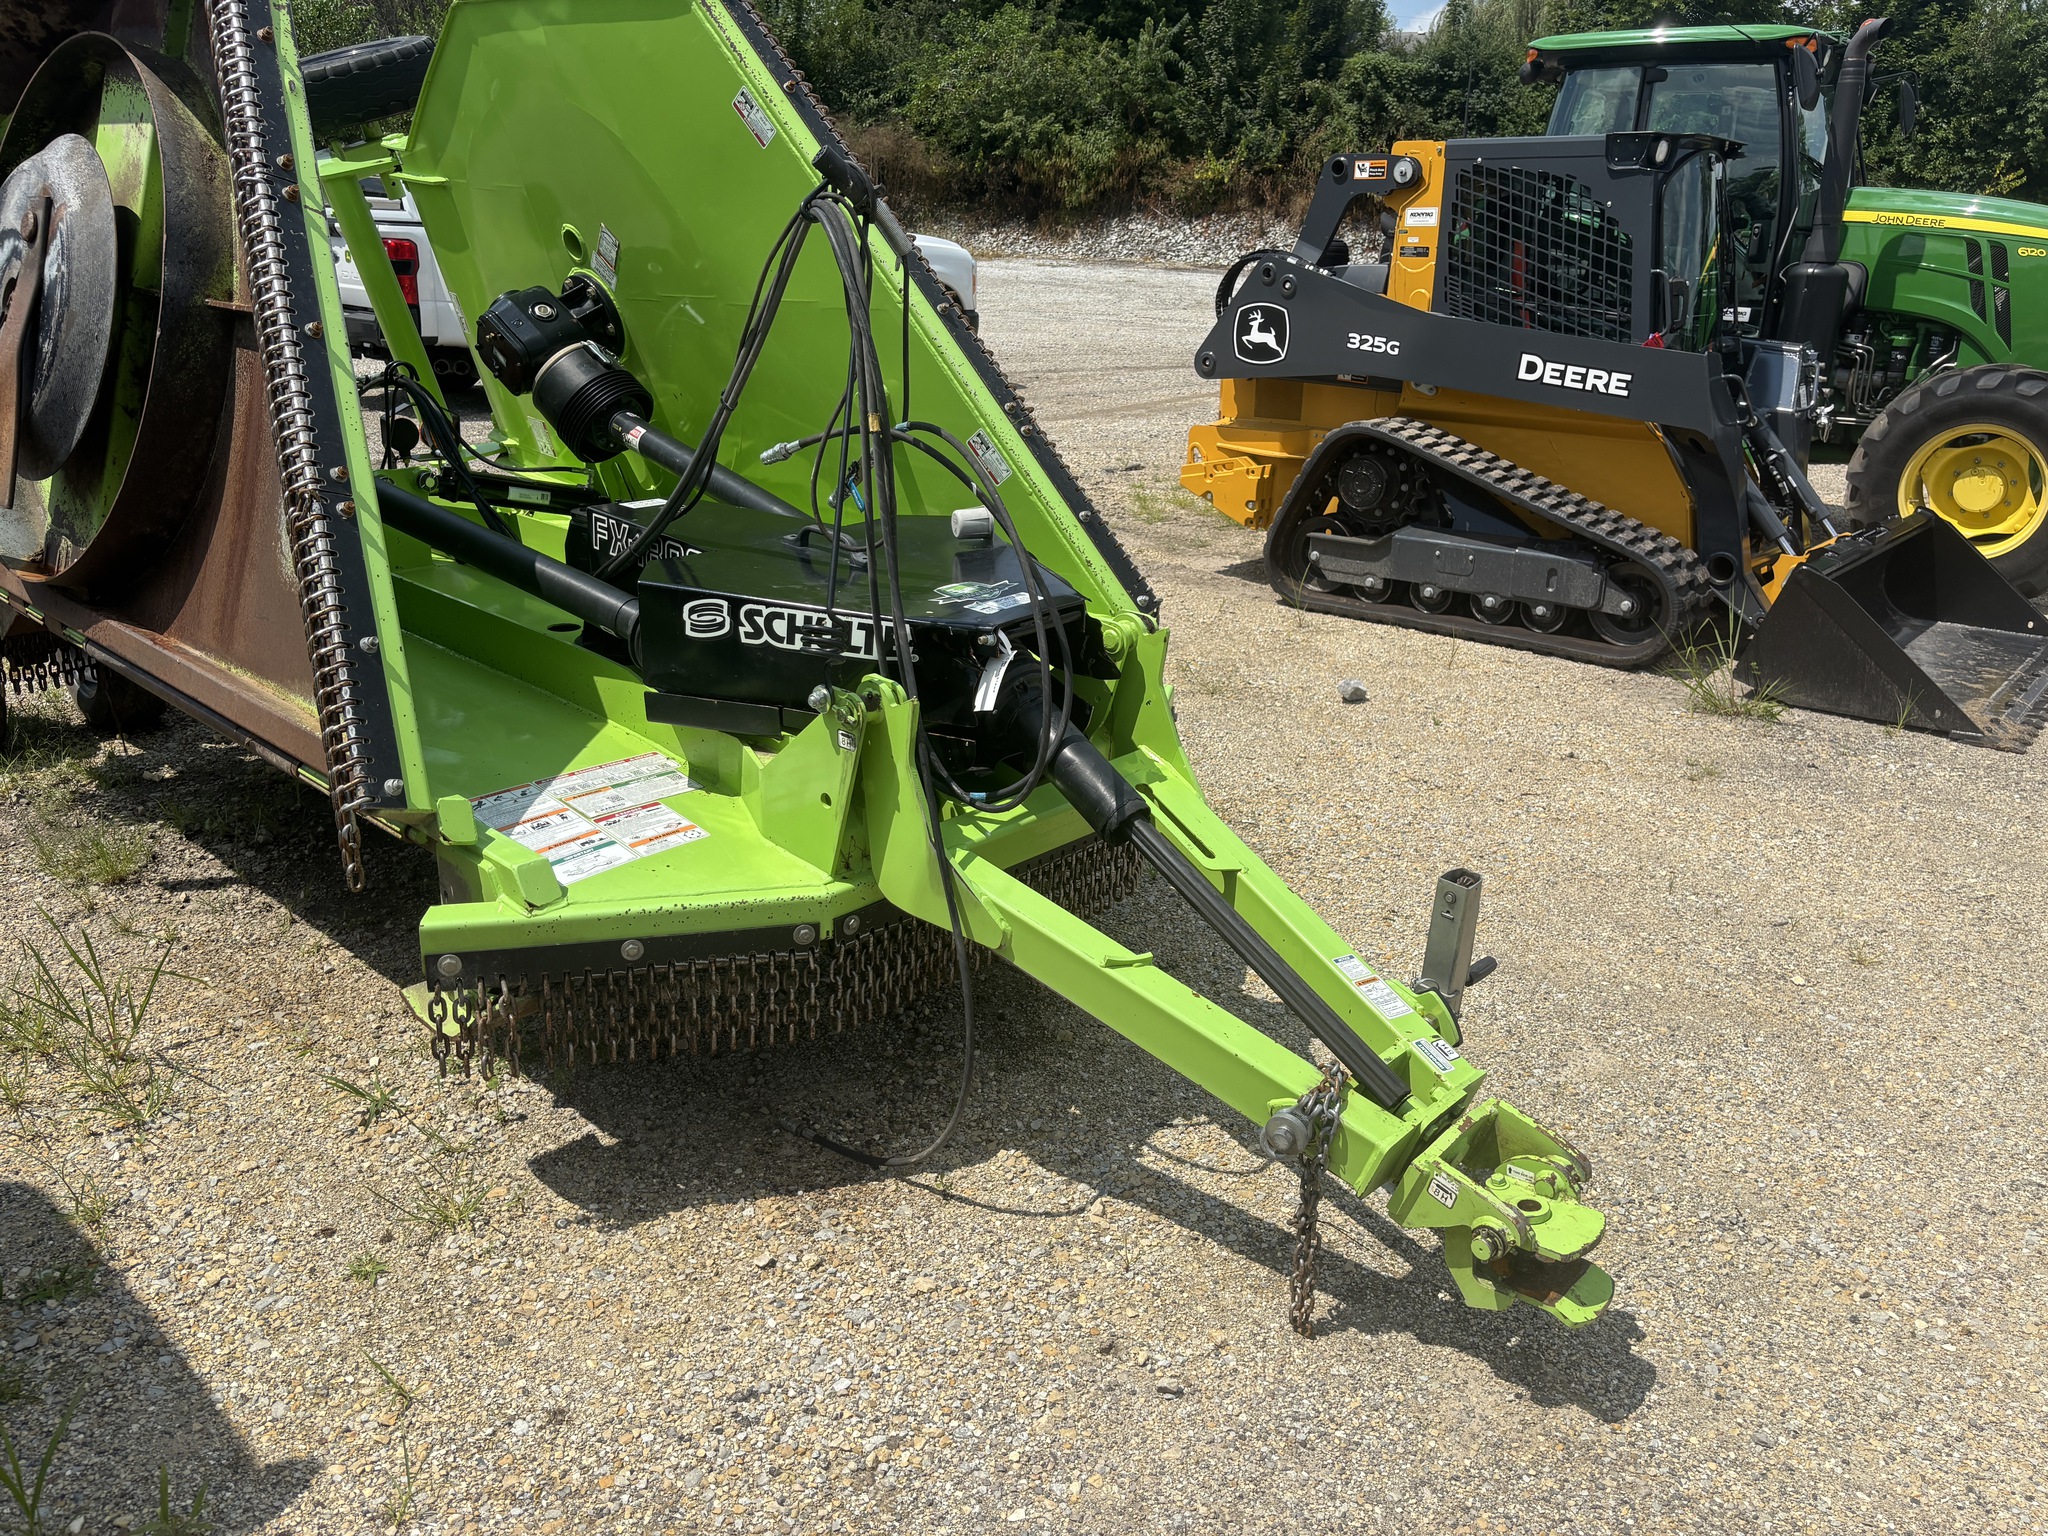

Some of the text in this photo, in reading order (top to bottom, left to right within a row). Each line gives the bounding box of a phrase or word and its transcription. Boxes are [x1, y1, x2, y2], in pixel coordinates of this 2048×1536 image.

[1872, 214, 1946, 227] JOHN DEERE
[2017, 247, 2047, 257] 6120
[1346, 332, 1400, 356] 325G
[1517, 352, 1632, 397] DEERE
